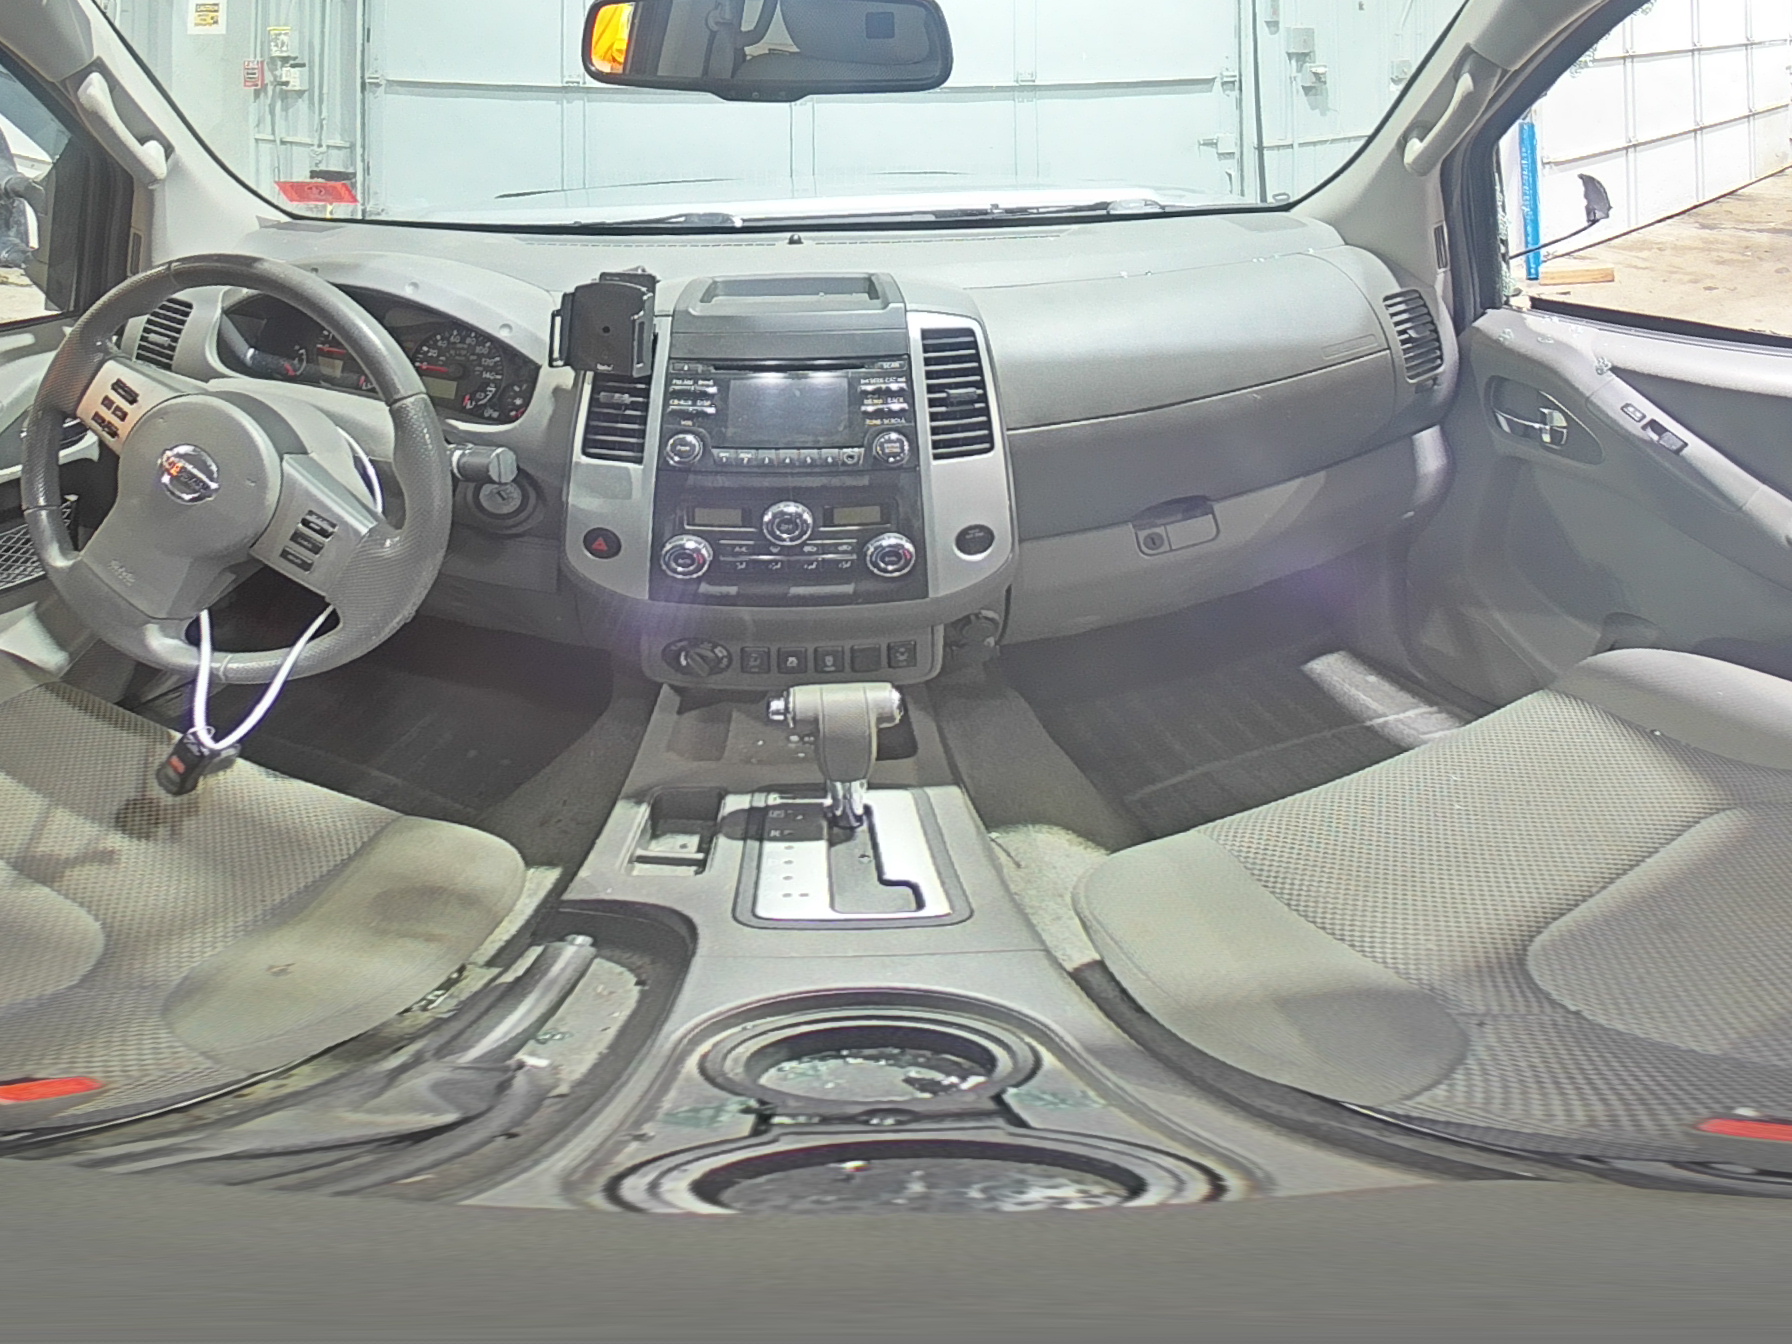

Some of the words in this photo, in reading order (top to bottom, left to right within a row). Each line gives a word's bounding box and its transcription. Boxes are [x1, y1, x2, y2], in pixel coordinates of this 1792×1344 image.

[450, 335, 461, 344] 60
[427, 348, 438, 357] 20
[475, 346, 489, 355] 100
[481, 358, 495, 366] 120
[482, 371, 496, 380] 140
